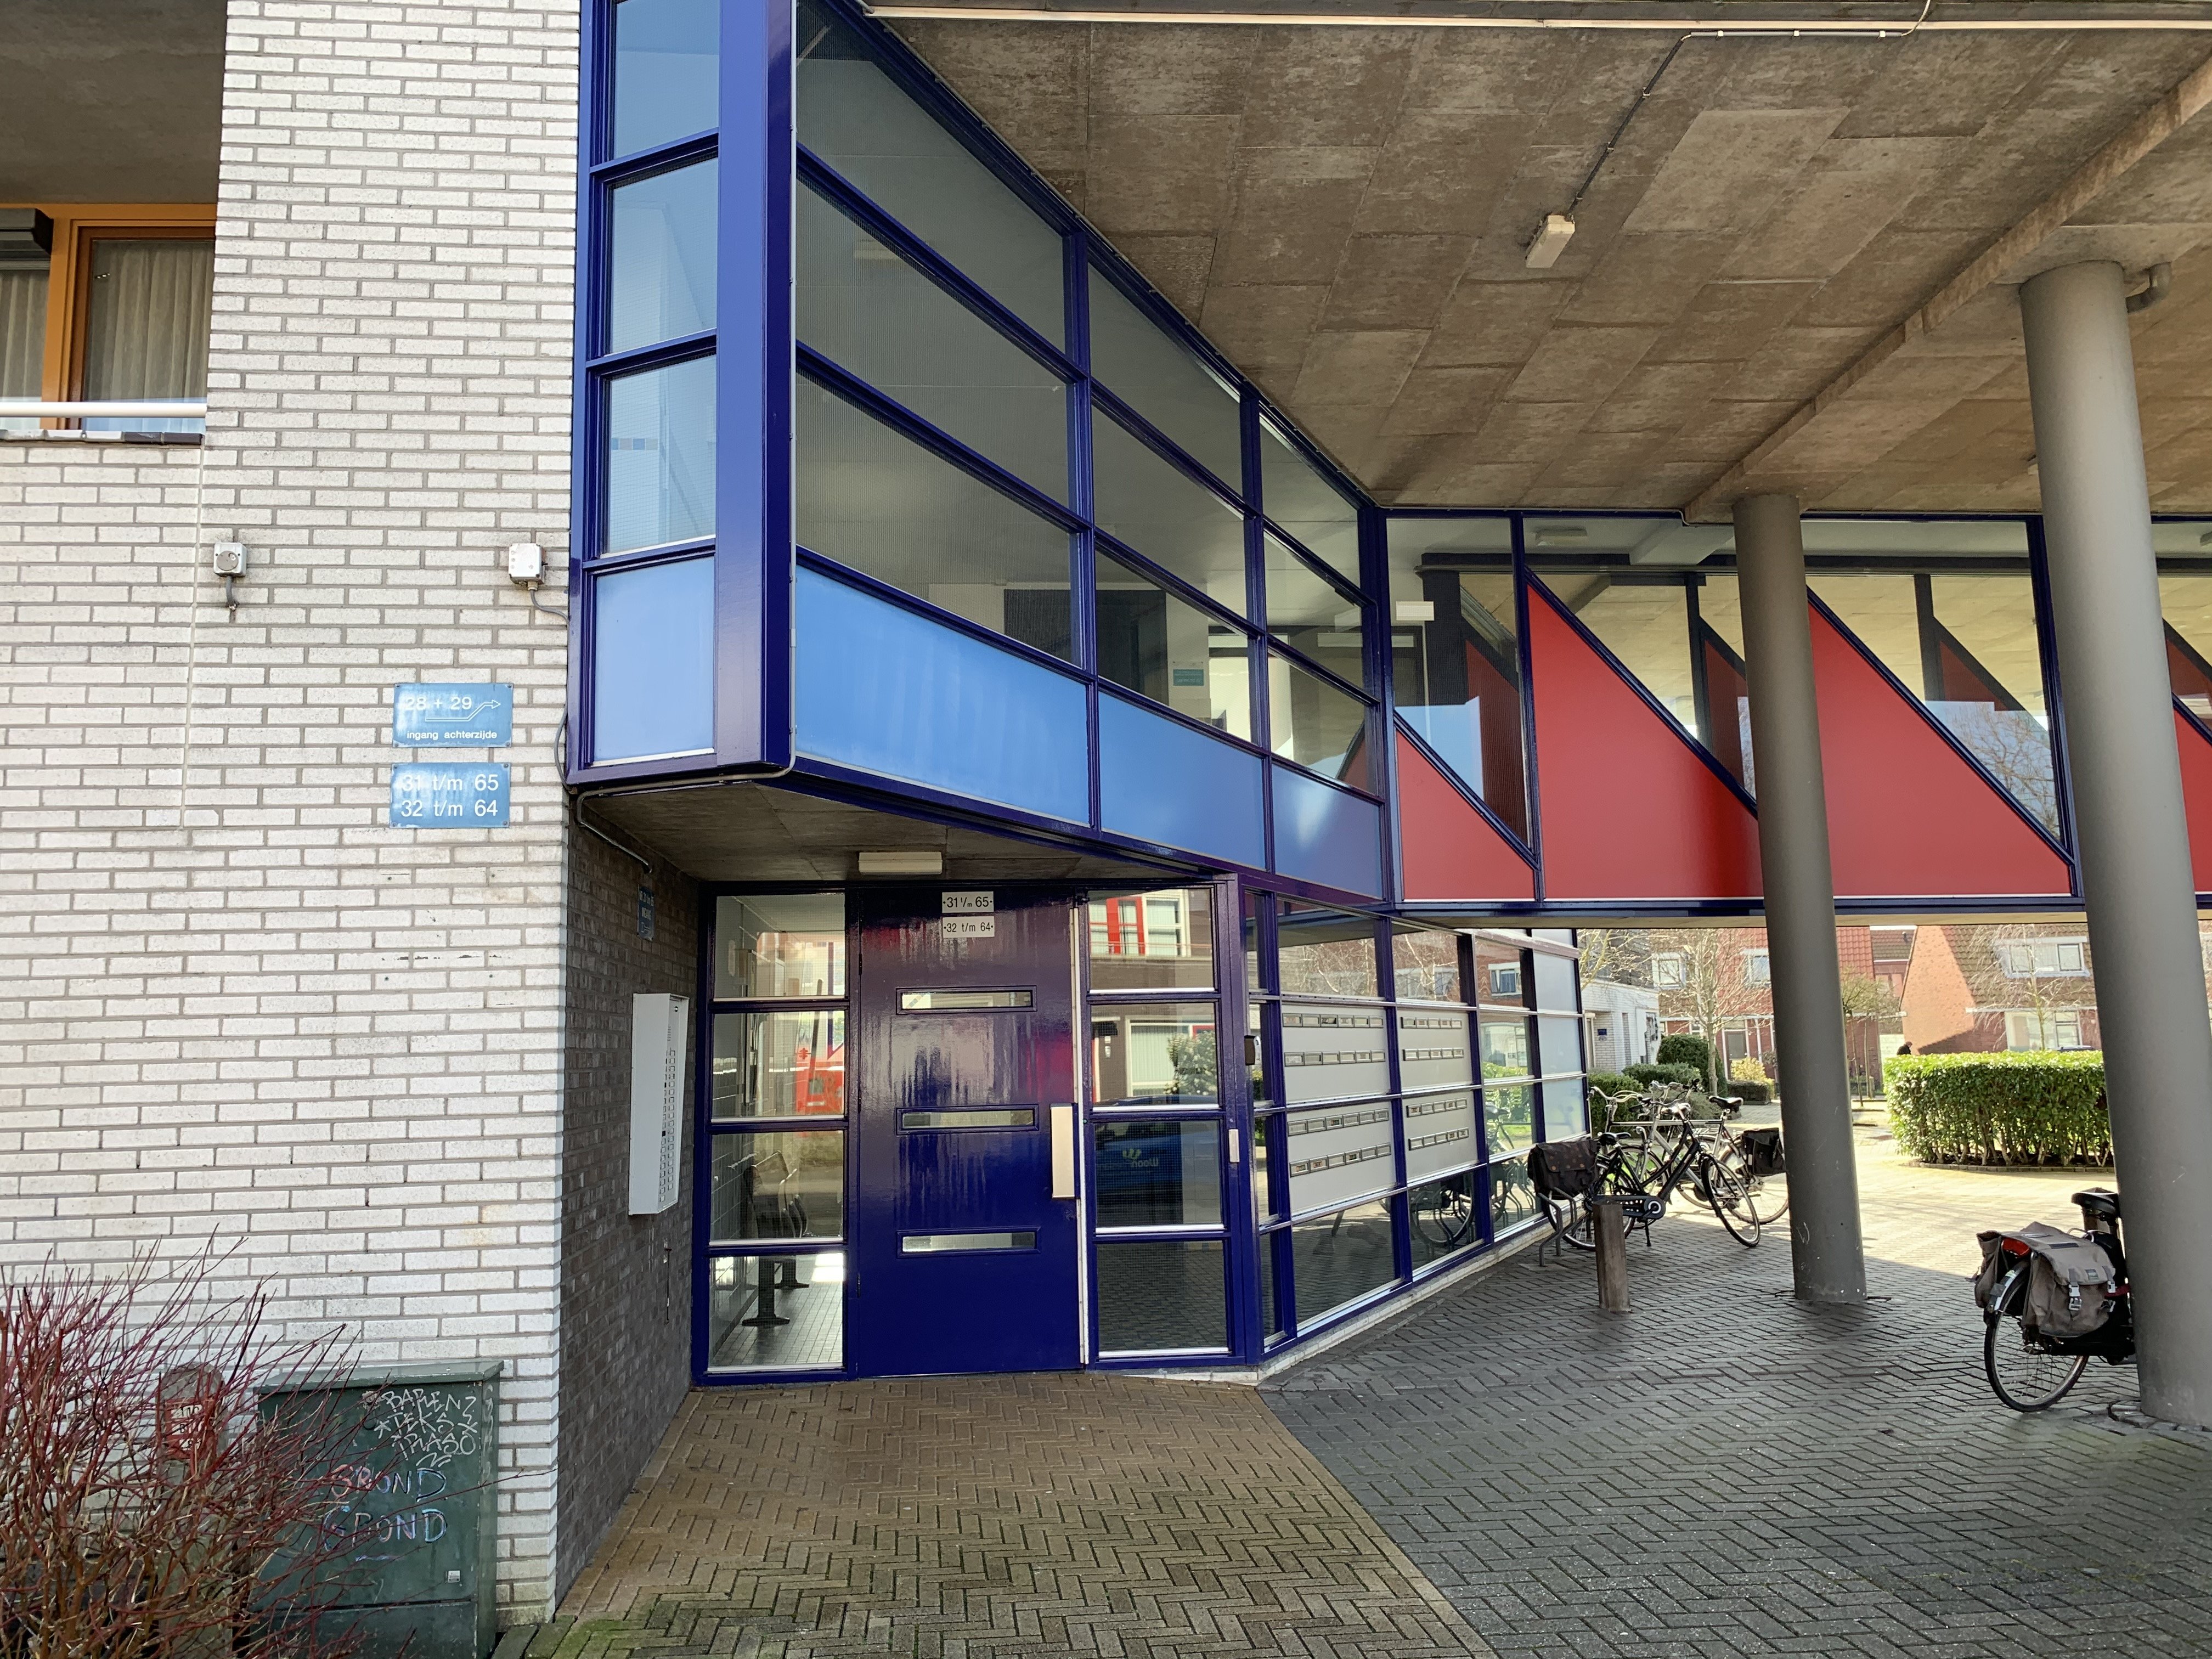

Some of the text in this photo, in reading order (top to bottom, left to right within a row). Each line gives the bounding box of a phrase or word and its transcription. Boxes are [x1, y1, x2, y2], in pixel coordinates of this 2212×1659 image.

[405, 697, 426, 710] 28
[450, 697, 472, 710] 29
[407, 730, 497, 740] ingang achterzijde
[402, 774, 498, 791] 31 t/m 65
[401, 799, 498, 816] 32 t/m 64
[947, 897, 958, 907] 31
[975, 896, 989, 907] 65
[947, 922, 990, 932] 32 t/m 64
